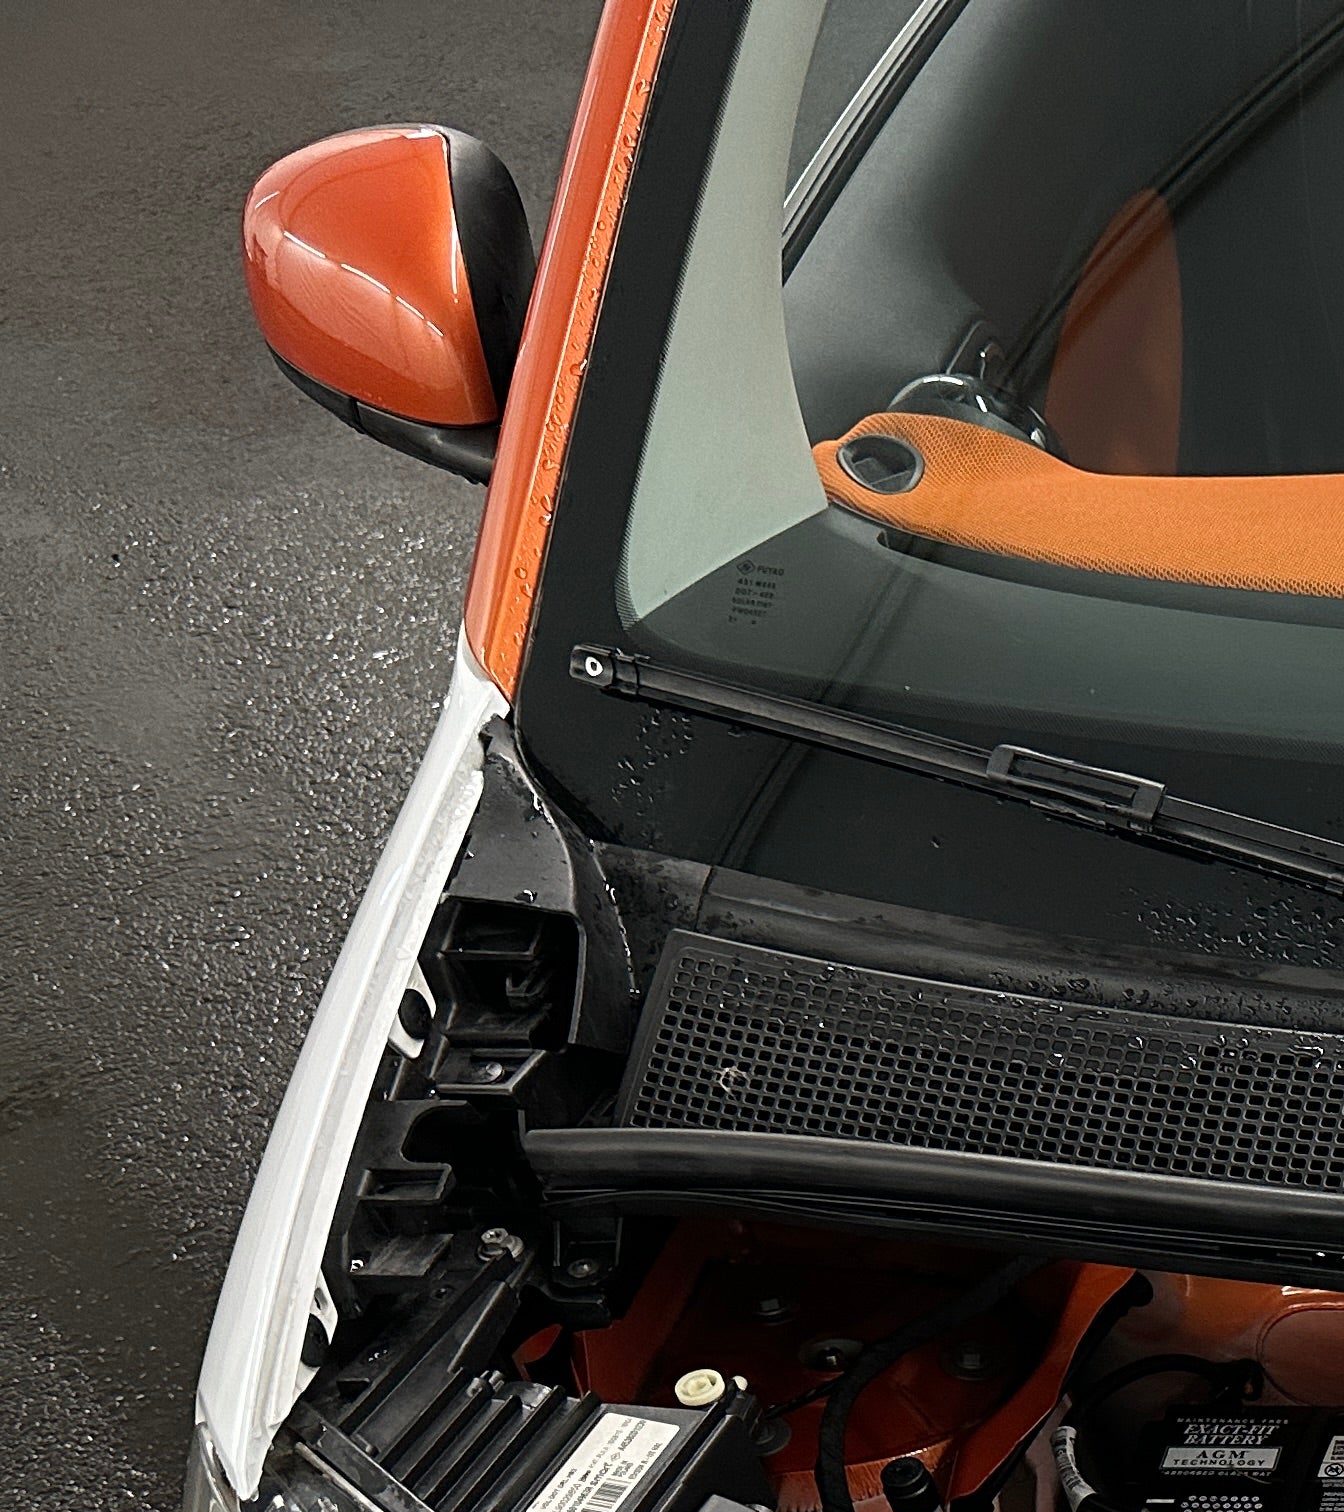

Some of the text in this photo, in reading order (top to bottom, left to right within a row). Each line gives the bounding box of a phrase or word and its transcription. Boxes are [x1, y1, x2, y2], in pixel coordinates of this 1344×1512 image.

[1183, 1424, 1280, 1435] EXACT-FIT
[1184, 1434, 1269, 1445] BATTERY
[1196, 1450, 1248, 1459] AGM
